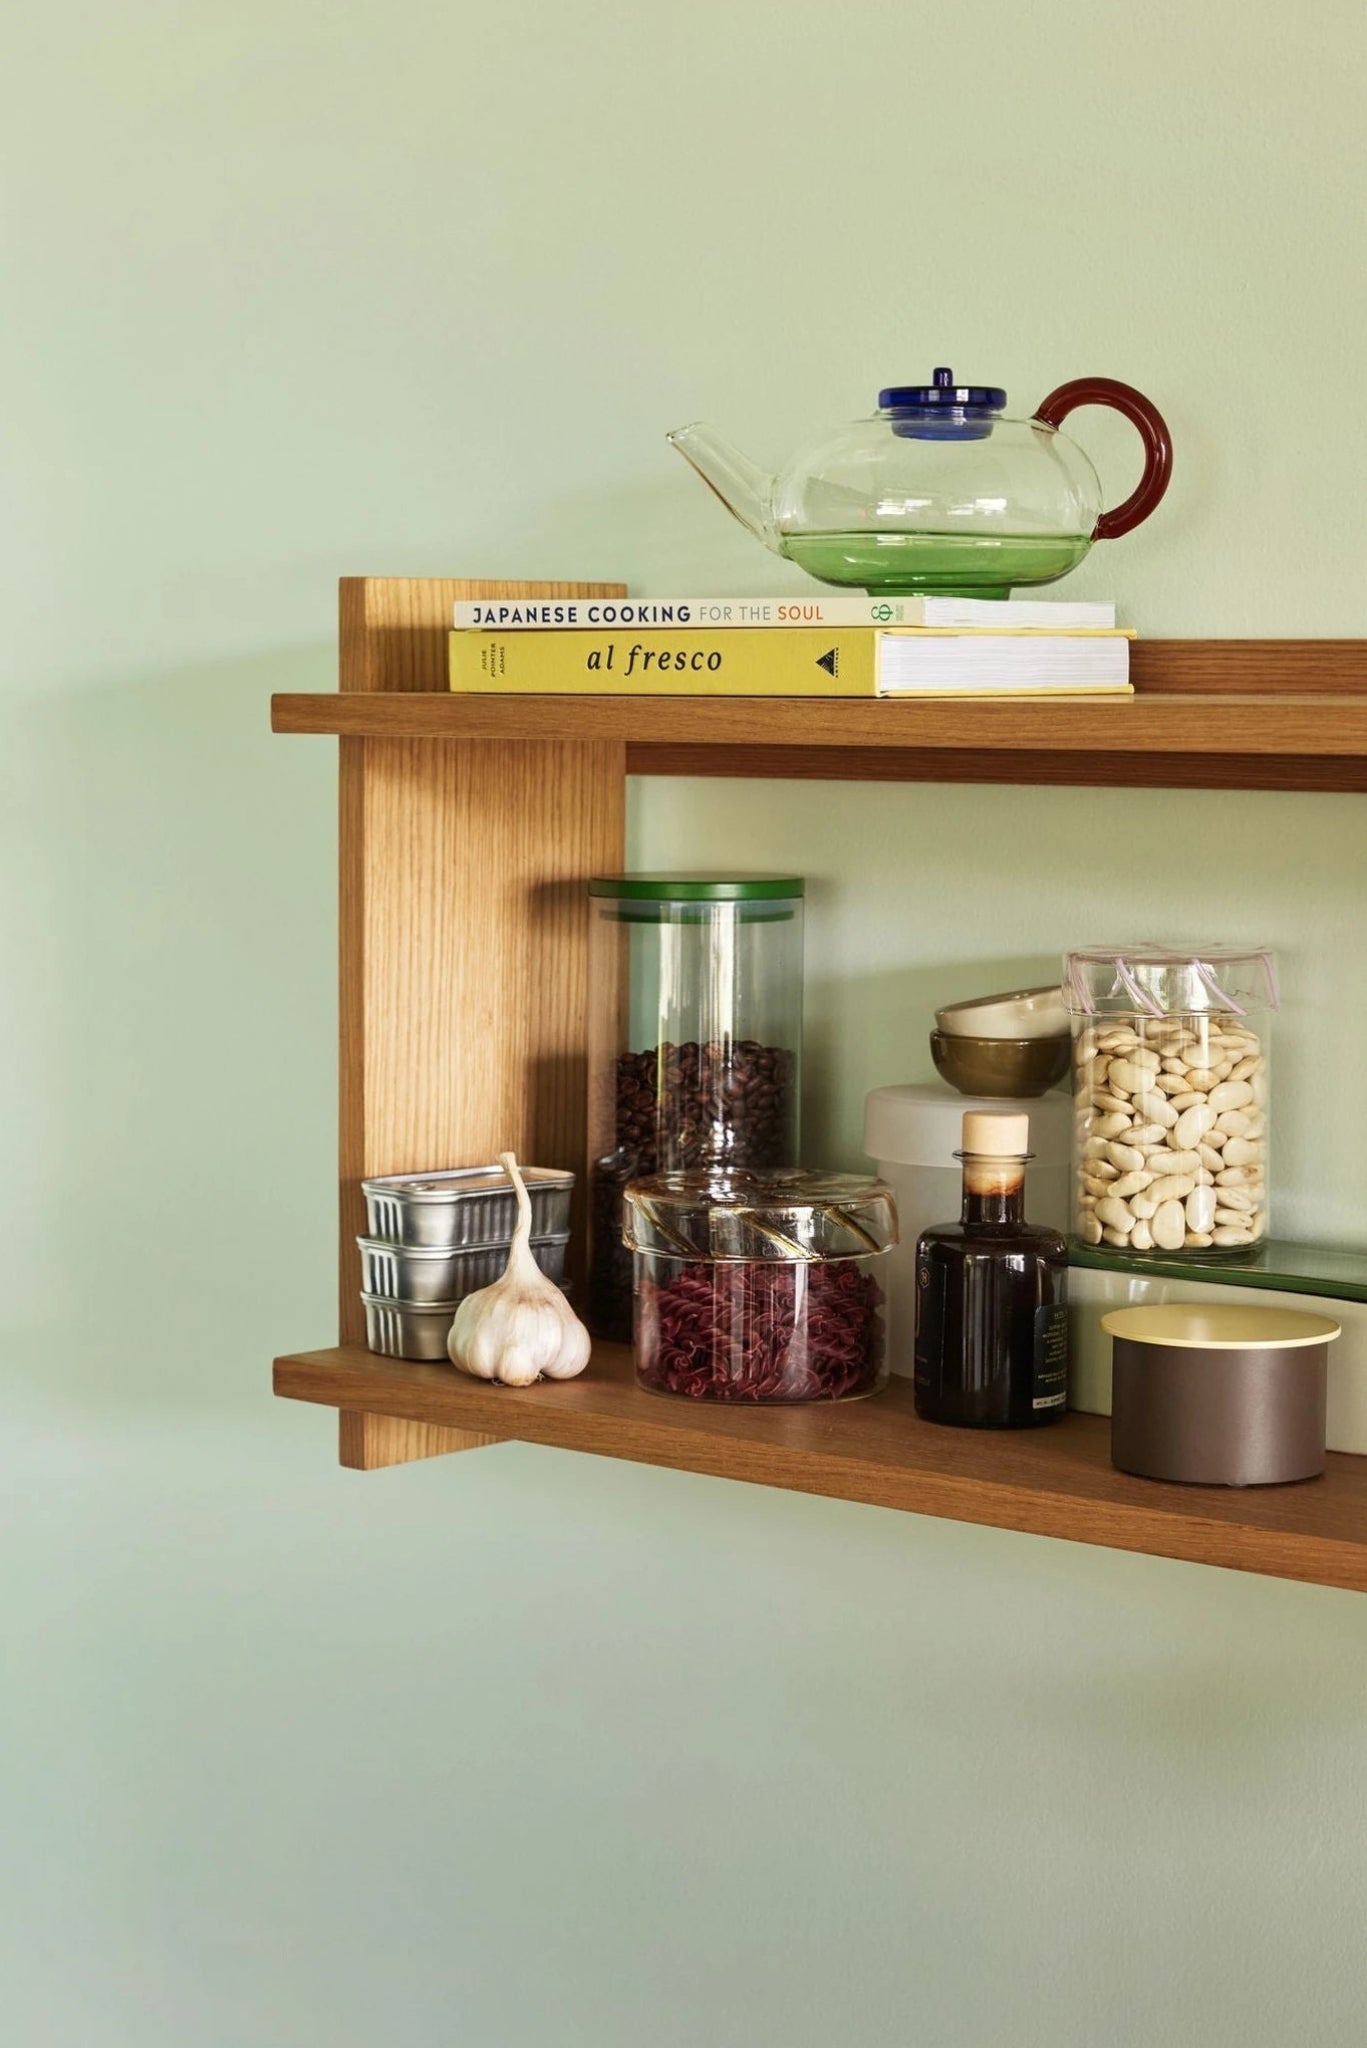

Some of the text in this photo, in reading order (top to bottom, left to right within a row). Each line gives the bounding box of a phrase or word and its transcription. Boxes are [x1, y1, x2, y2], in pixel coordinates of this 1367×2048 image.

[473, 605, 824, 624] JAPANESE COOKING FOR THE SOUL
[587, 644, 722, 676] al fresco
